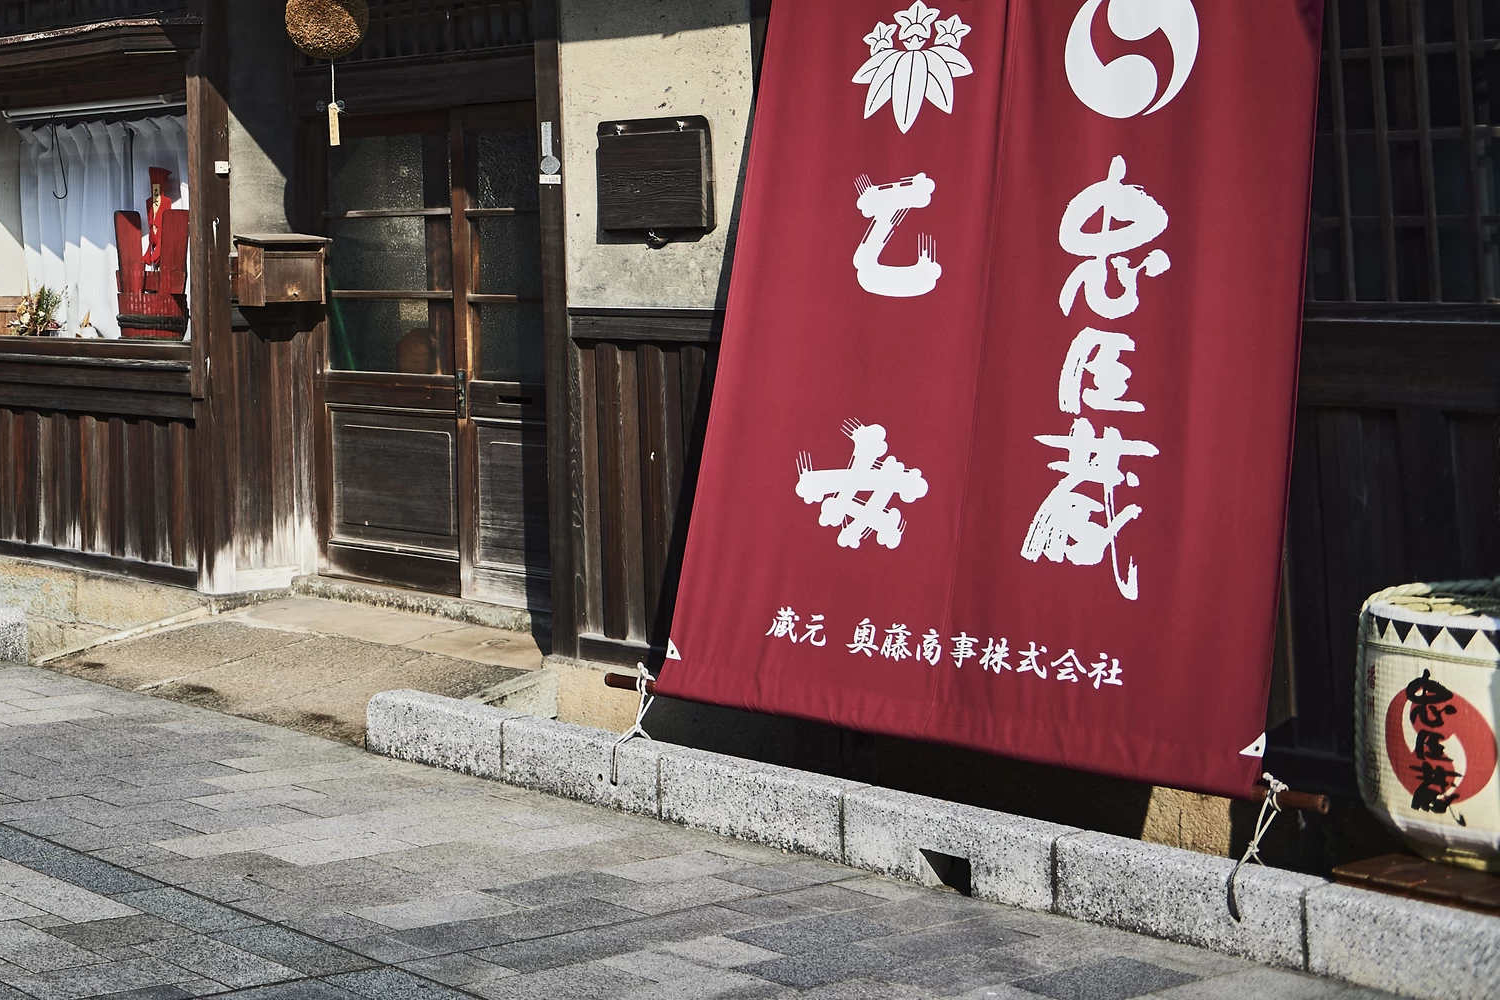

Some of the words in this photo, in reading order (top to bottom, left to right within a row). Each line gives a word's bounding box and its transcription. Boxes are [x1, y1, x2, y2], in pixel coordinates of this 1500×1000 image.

[795, 173, 942, 549] 乙女
[1021, 155, 1170, 600] 忠臣蔵
[766, 606, 826, 646] 蔵元
[846, 618, 1122, 689] 奥藤商事株式会社
[1406, 669, 1466, 827] 忠臣蔵
